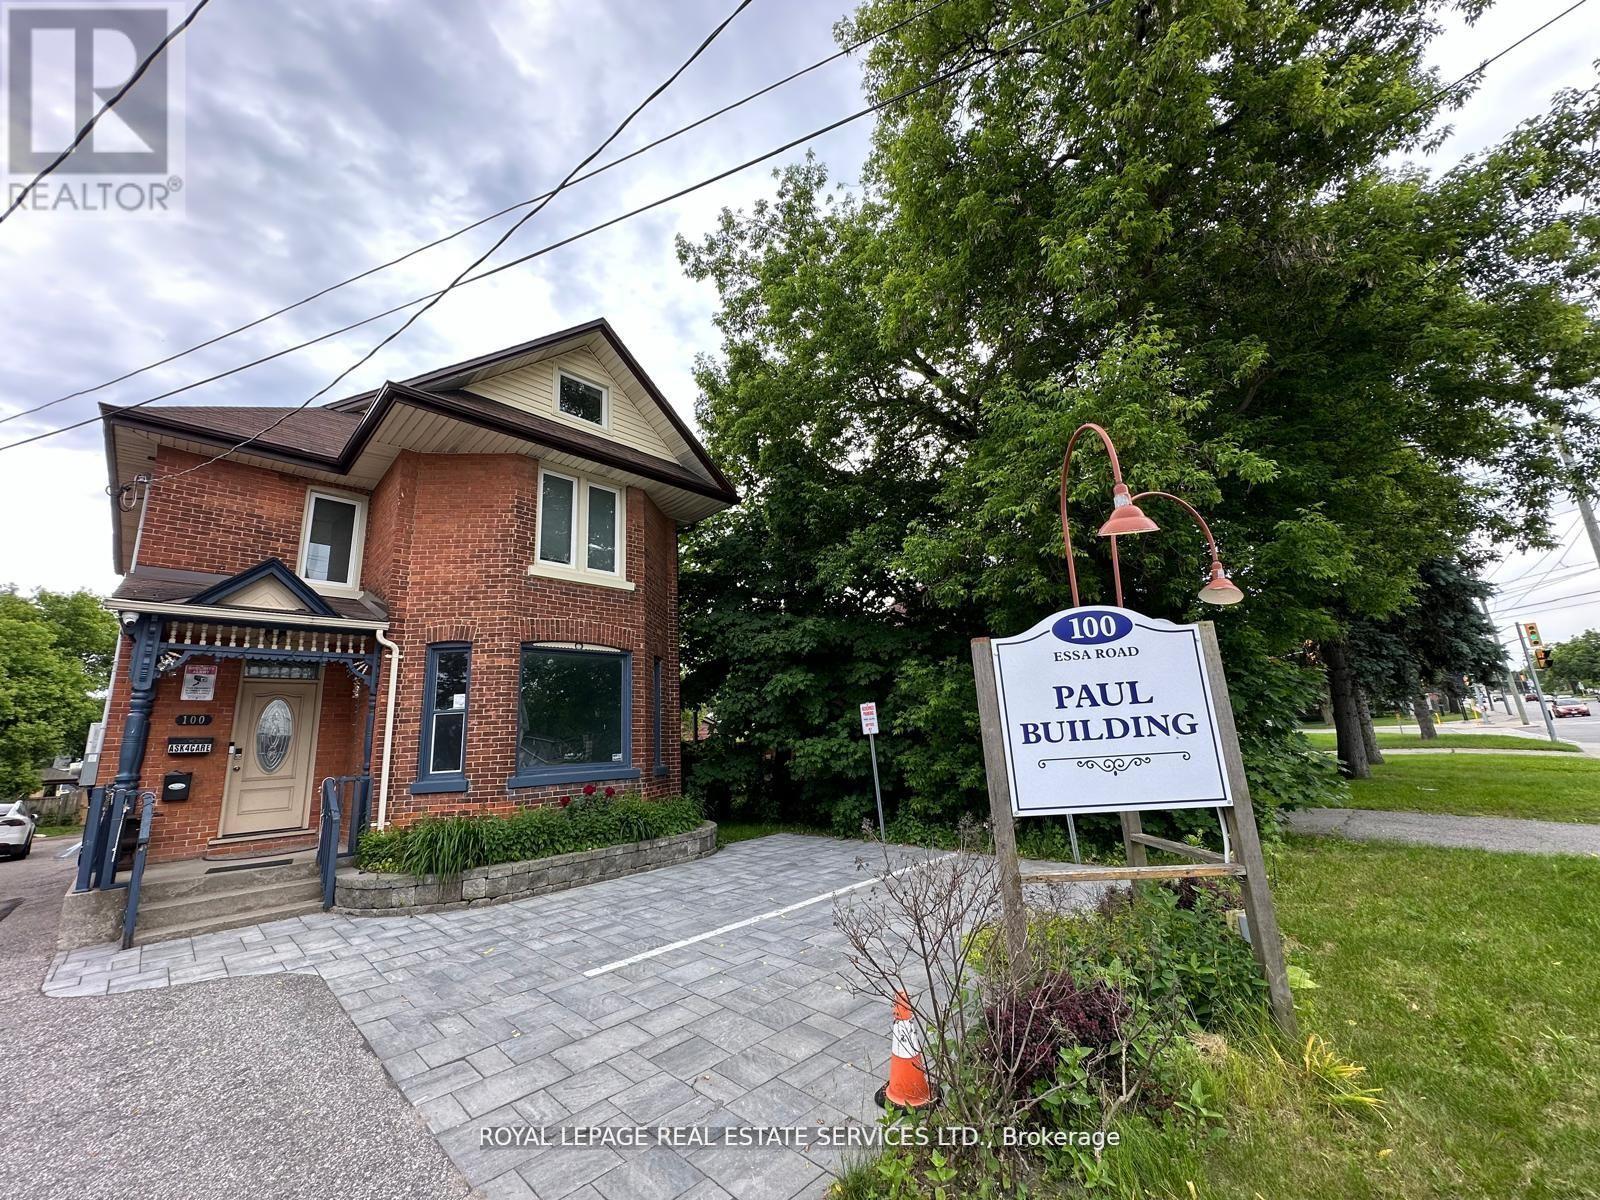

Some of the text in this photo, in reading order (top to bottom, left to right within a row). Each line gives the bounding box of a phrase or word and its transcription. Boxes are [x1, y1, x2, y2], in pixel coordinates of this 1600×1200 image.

[1068, 615, 1117, 640] 100
[1053, 646, 1140, 662] ESSA ROAD
[1052, 680, 1154, 710] PAUL
[182, 715, 206, 725] 100
[1020, 712, 1199, 745] BUILDING
[168, 744, 211, 753] ASK4CARE
